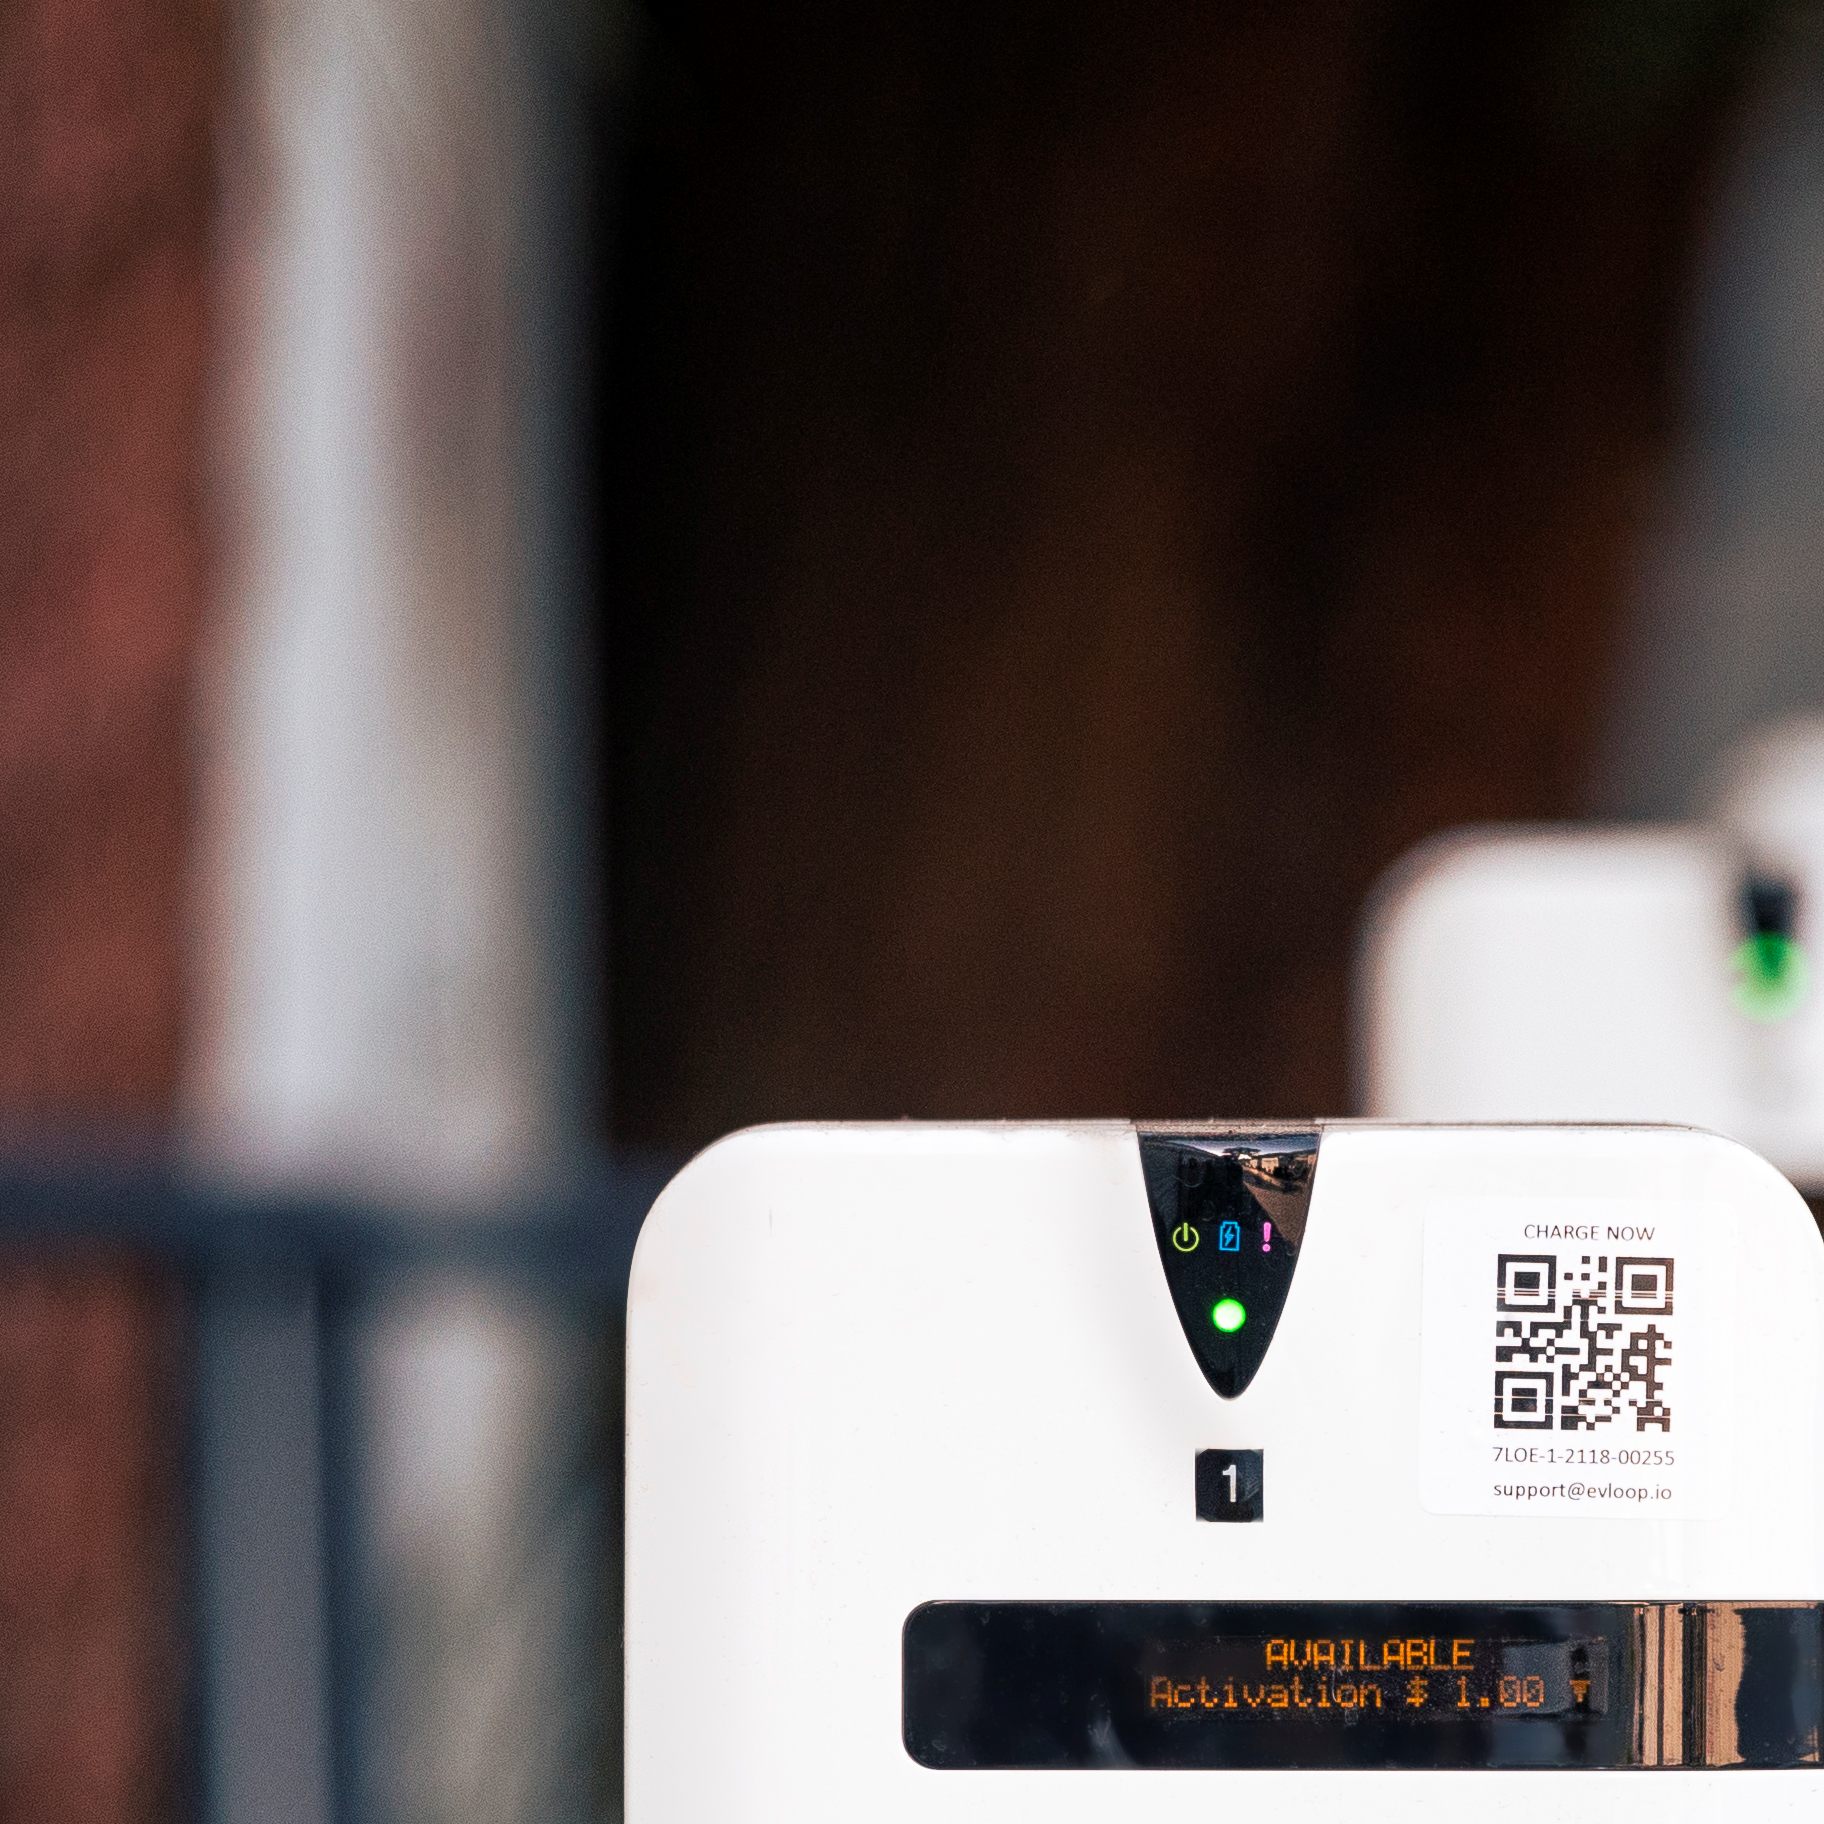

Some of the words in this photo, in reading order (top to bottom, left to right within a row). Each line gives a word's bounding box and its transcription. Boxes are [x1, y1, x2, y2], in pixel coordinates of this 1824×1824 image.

[1523, 1223, 1600, 1241] CHARGE
[1606, 1225, 1656, 1242] NOW
[1492, 1446, 1676, 1467] 7LOE-1-2118-00255
[1221, 1464, 1238, 1504] 1
[1492, 1482, 1673, 1503] support@evloop.io
[1265, 1638, 1476, 1671] AVAILABLE
[1150, 1675, 1383, 1709] Activation
[1406, 1675, 1429, 1709] $
[1456, 1675, 1546, 1709] 1.00
